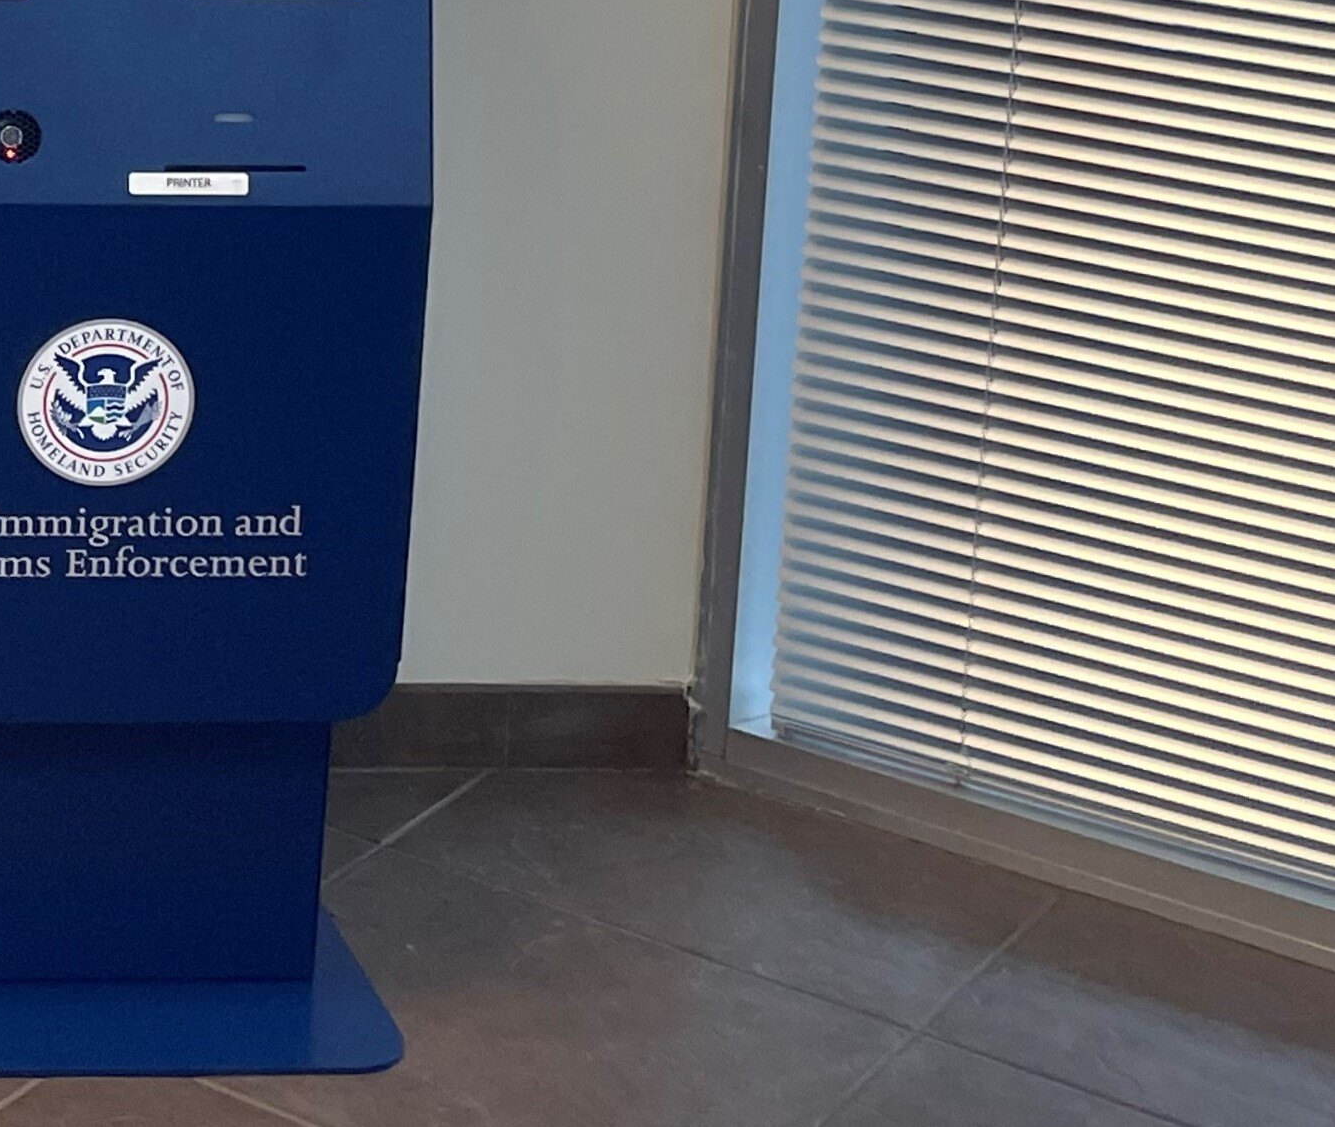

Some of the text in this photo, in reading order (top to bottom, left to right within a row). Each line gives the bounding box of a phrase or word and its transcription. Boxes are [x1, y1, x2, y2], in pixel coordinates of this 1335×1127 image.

[167, 177, 212, 188] PRINTER
[30, 328, 185, 391] U.S. DEPARTMENT OF
[27, 411, 183, 477] HOMELAND SECURITY
[234, 505, 303, 537] and
[64, 544, 307, 578] Enforcement
